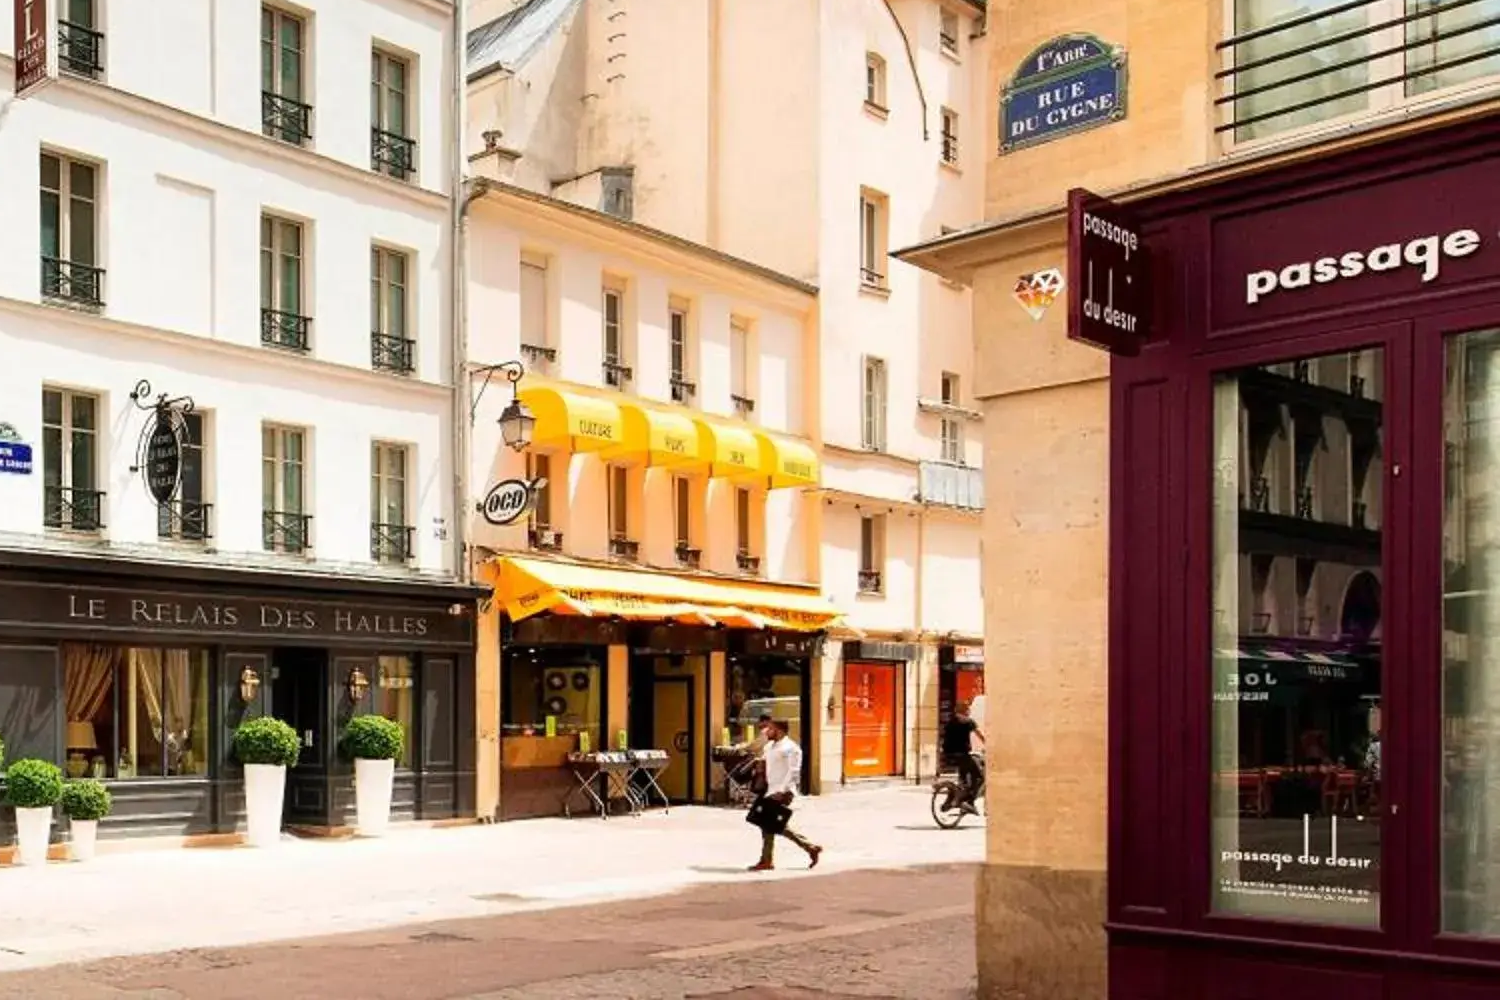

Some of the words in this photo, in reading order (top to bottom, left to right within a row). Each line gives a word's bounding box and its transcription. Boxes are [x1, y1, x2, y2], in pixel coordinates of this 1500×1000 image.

[1011, 115, 1039, 136] DU
[1046, 94, 1113, 125] CYGNE
[1038, 81, 1085, 109] RUE
[1083, 212, 1138, 262] passage
[1246, 228, 1481, 304] passage
[488, 489, 524, 513] OCD
[68, 595, 106, 619] LE
[131, 599, 239, 626] RELAIS
[260, 604, 317, 630] DES
[334, 609, 428, 636] HALLES
[1221, 851, 1293, 872] passage
